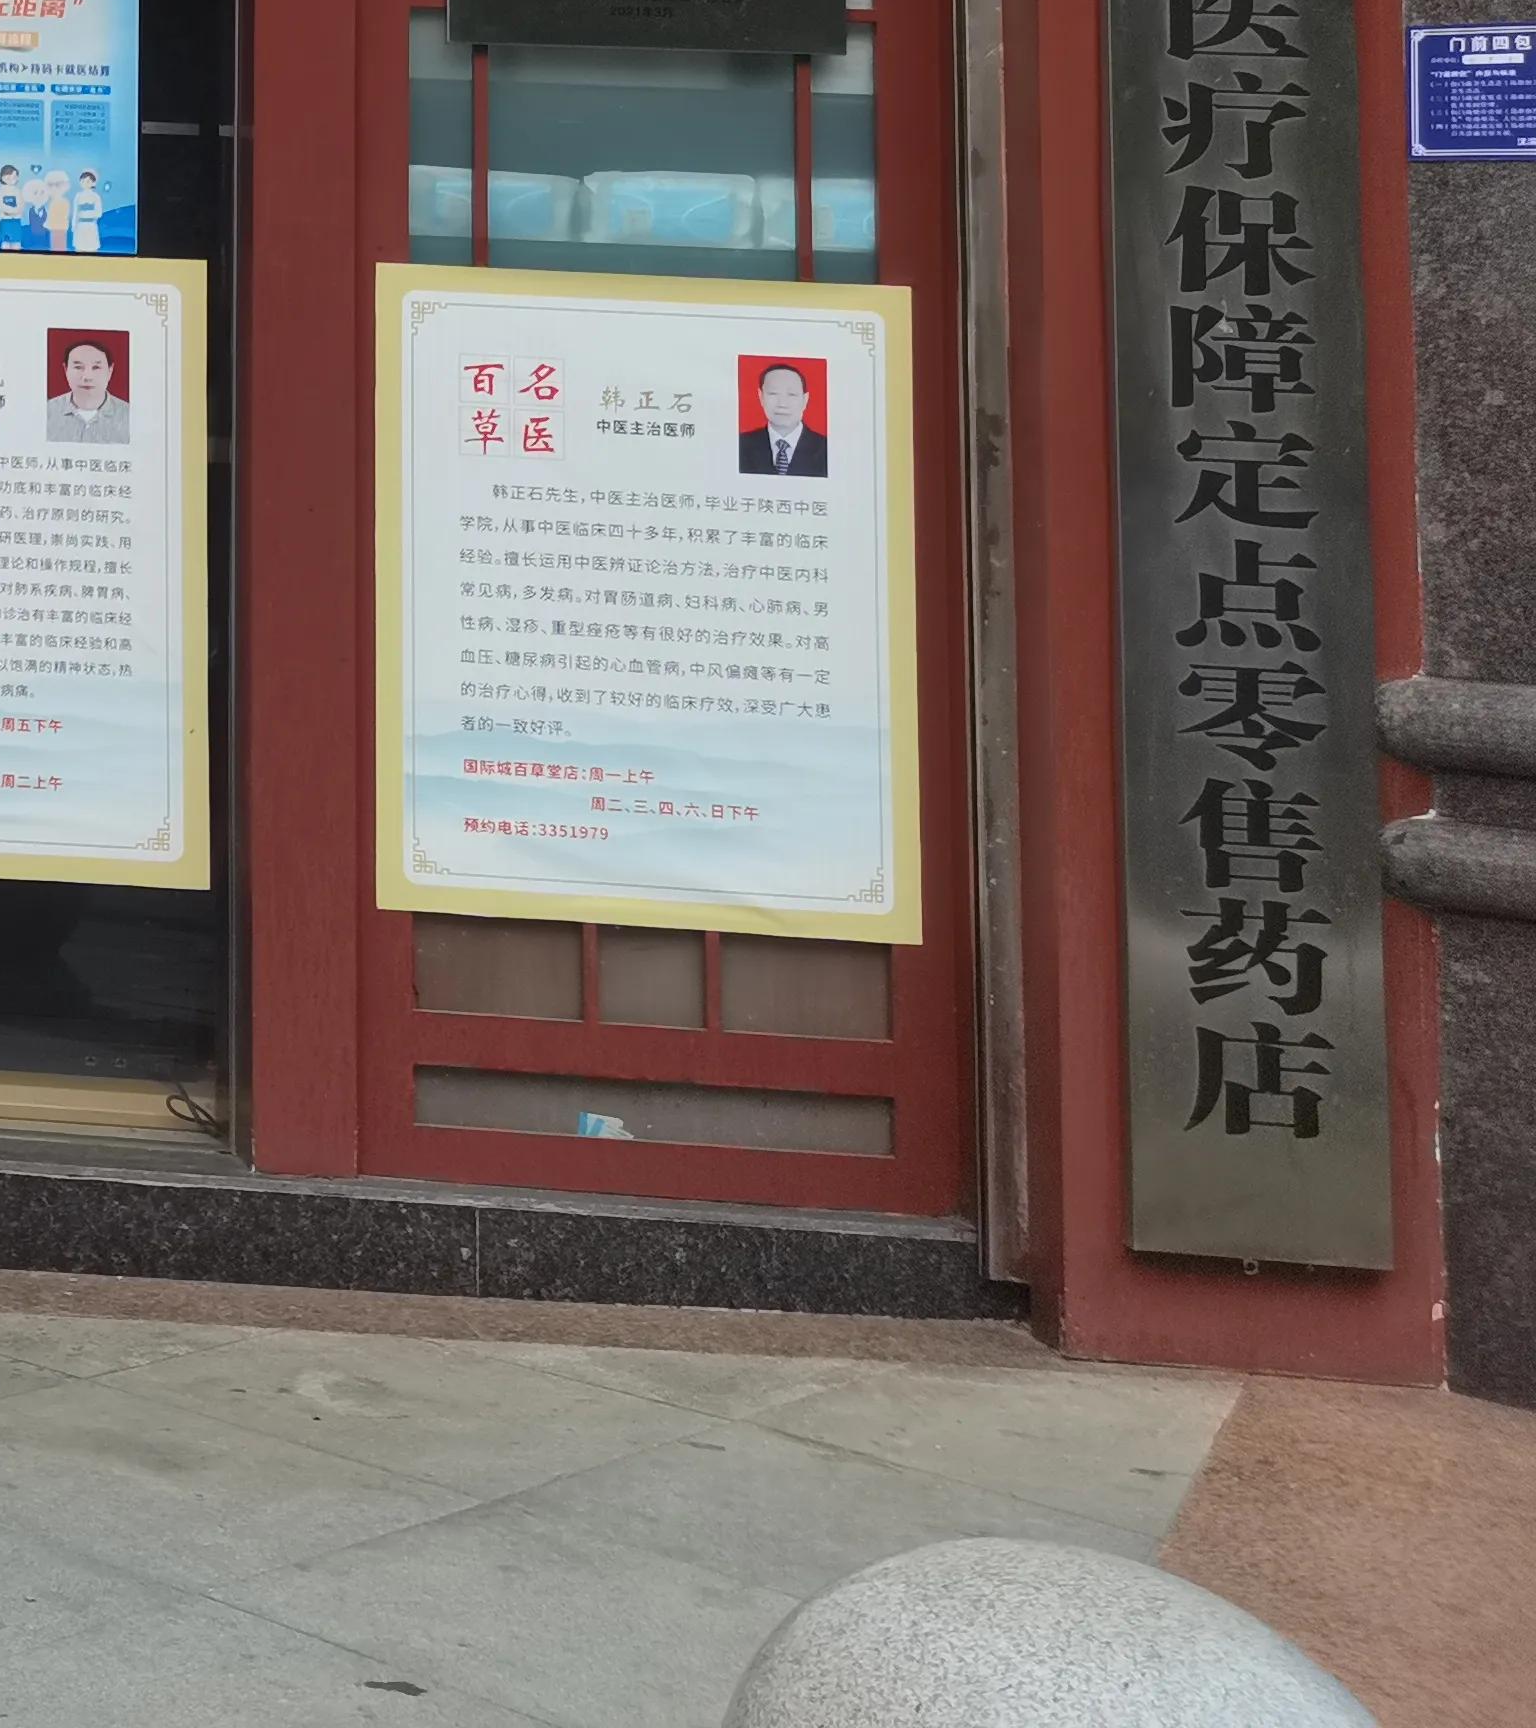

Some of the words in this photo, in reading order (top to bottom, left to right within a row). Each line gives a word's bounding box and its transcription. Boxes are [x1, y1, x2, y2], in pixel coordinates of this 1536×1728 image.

[598, 384, 695, 416] 韩正石
[595, 418, 696, 440] 中医主治医师
